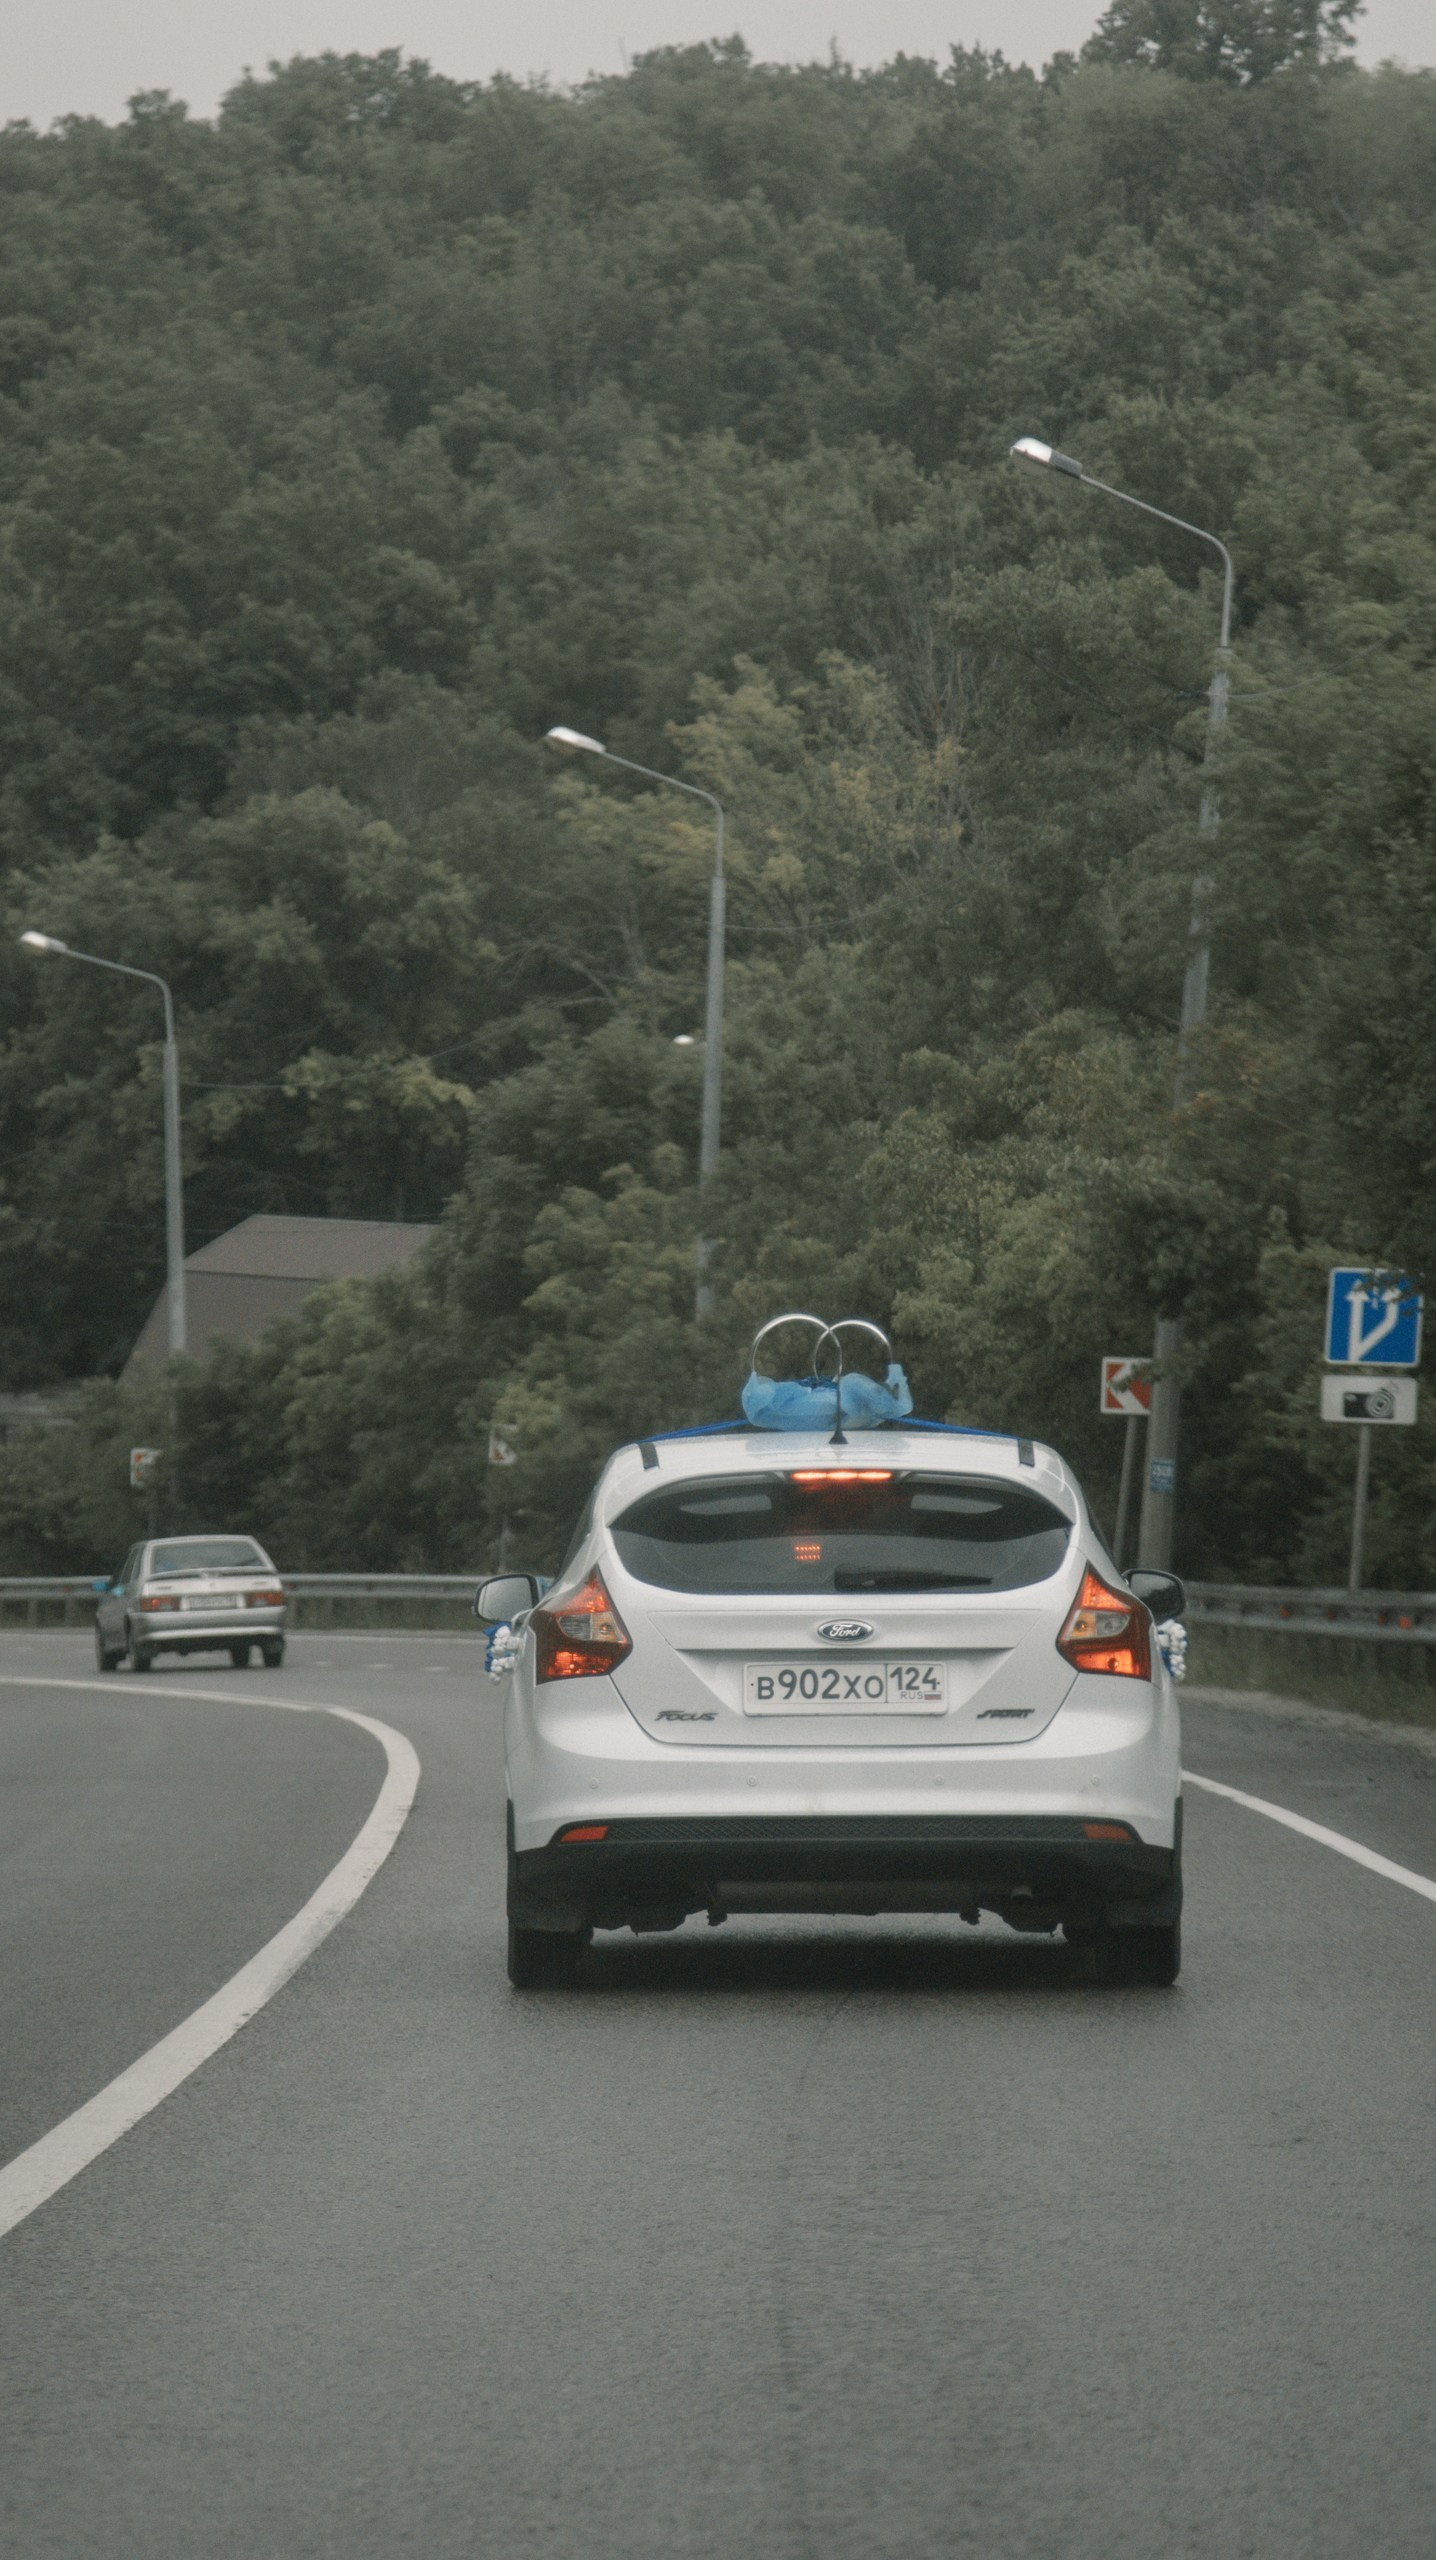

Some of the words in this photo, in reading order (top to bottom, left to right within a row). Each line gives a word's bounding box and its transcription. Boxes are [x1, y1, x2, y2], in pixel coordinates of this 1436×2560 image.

[829, 1624, 862, 1637] Ford
[889, 1667, 938, 1691] 124
[900, 1691, 924, 1700] RUS
